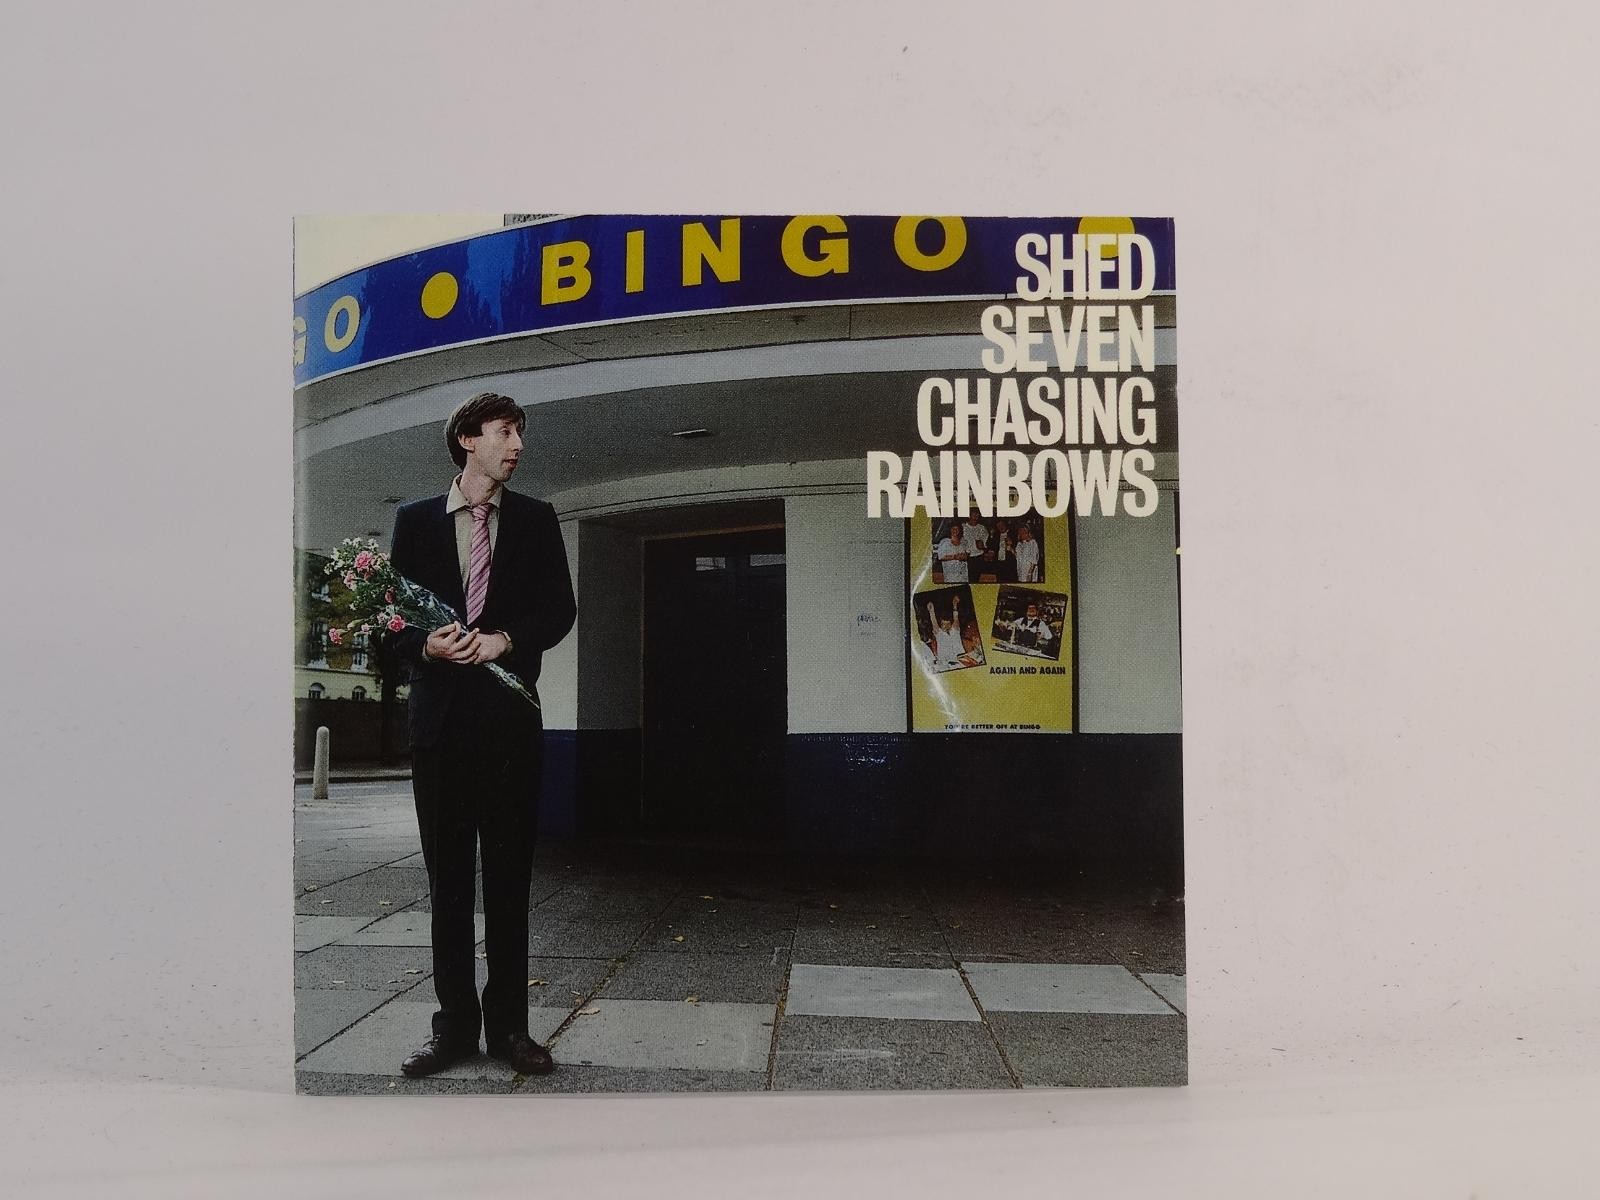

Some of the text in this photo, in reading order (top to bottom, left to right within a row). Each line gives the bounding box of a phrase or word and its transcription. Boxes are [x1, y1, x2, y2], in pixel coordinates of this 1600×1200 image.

[541, 215, 967, 306] BINGO
[1015, 233, 1156, 300] SHED
[981, 305, 1155, 373] SEVEN
[917, 377, 1157, 446] CHASING
[866, 449, 1159, 519] RAINBOWS
[989, 666, 1066, 675] AGAIN AND AGAIN
